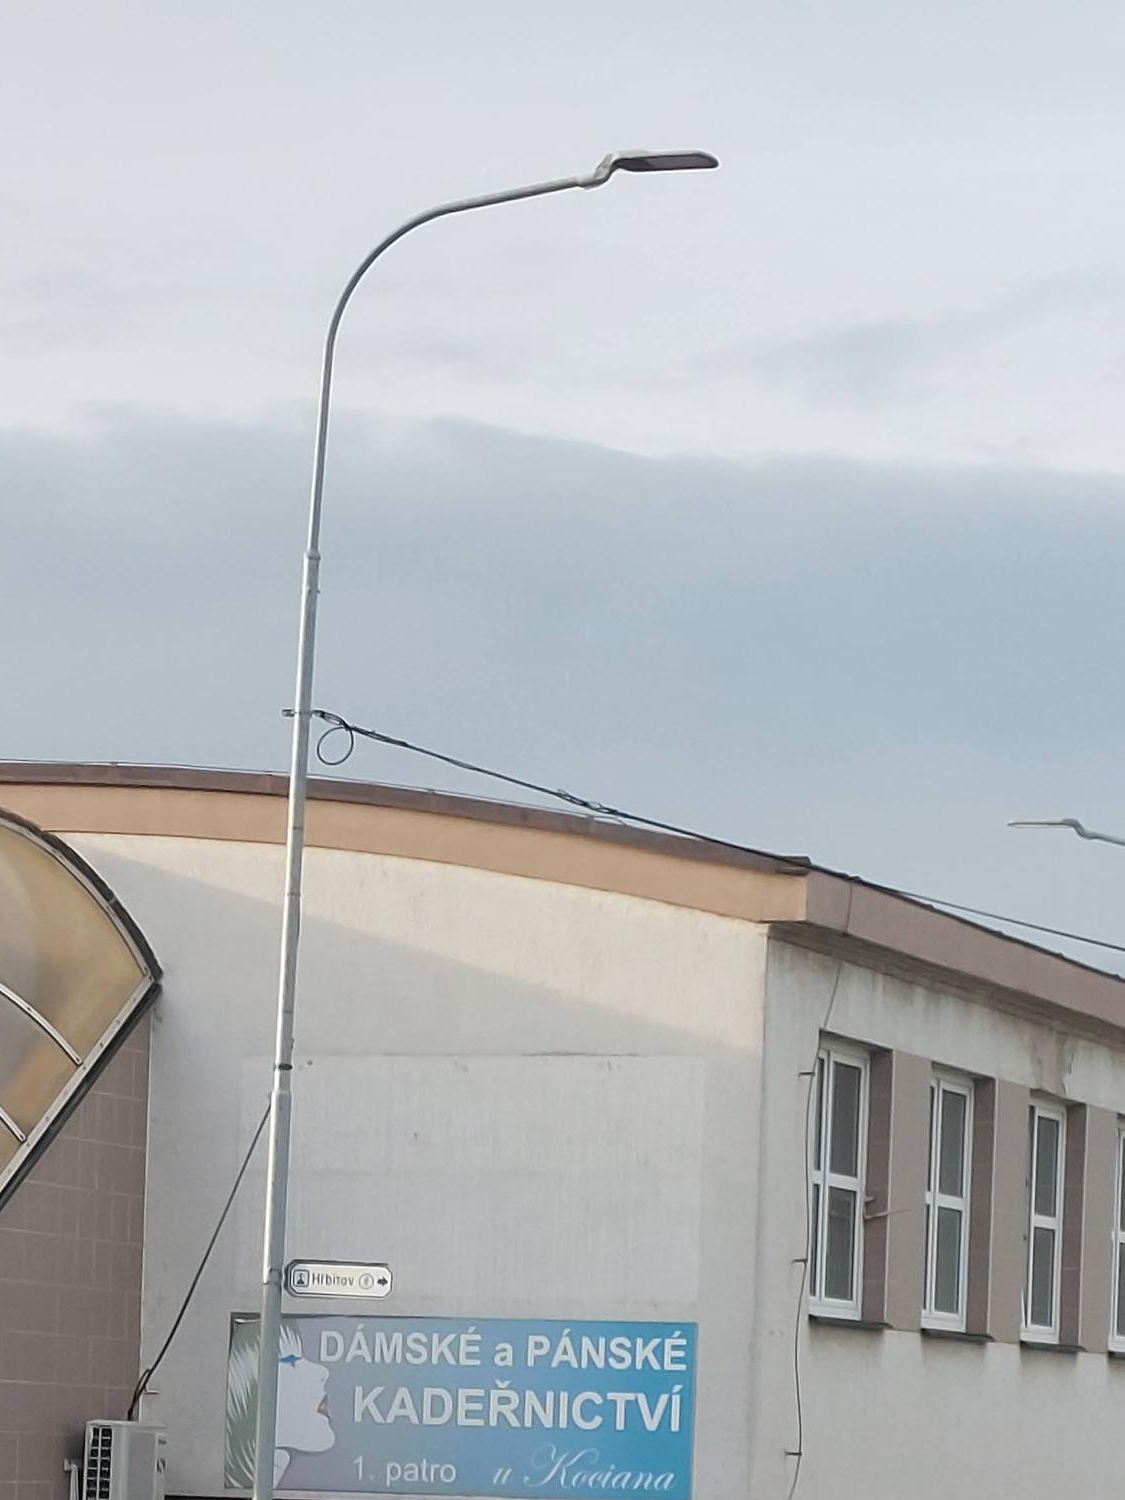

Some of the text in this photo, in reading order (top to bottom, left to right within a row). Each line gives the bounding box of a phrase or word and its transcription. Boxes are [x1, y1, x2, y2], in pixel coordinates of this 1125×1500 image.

[319, 1324, 688, 1371] DÁMSKÉ a PÁNSKÉ
[353, 1380, 683, 1432] KADEŘNICTVÍ
[352, 1456, 375, 1481] 1.
[386, 1457, 457, 1484] patro
